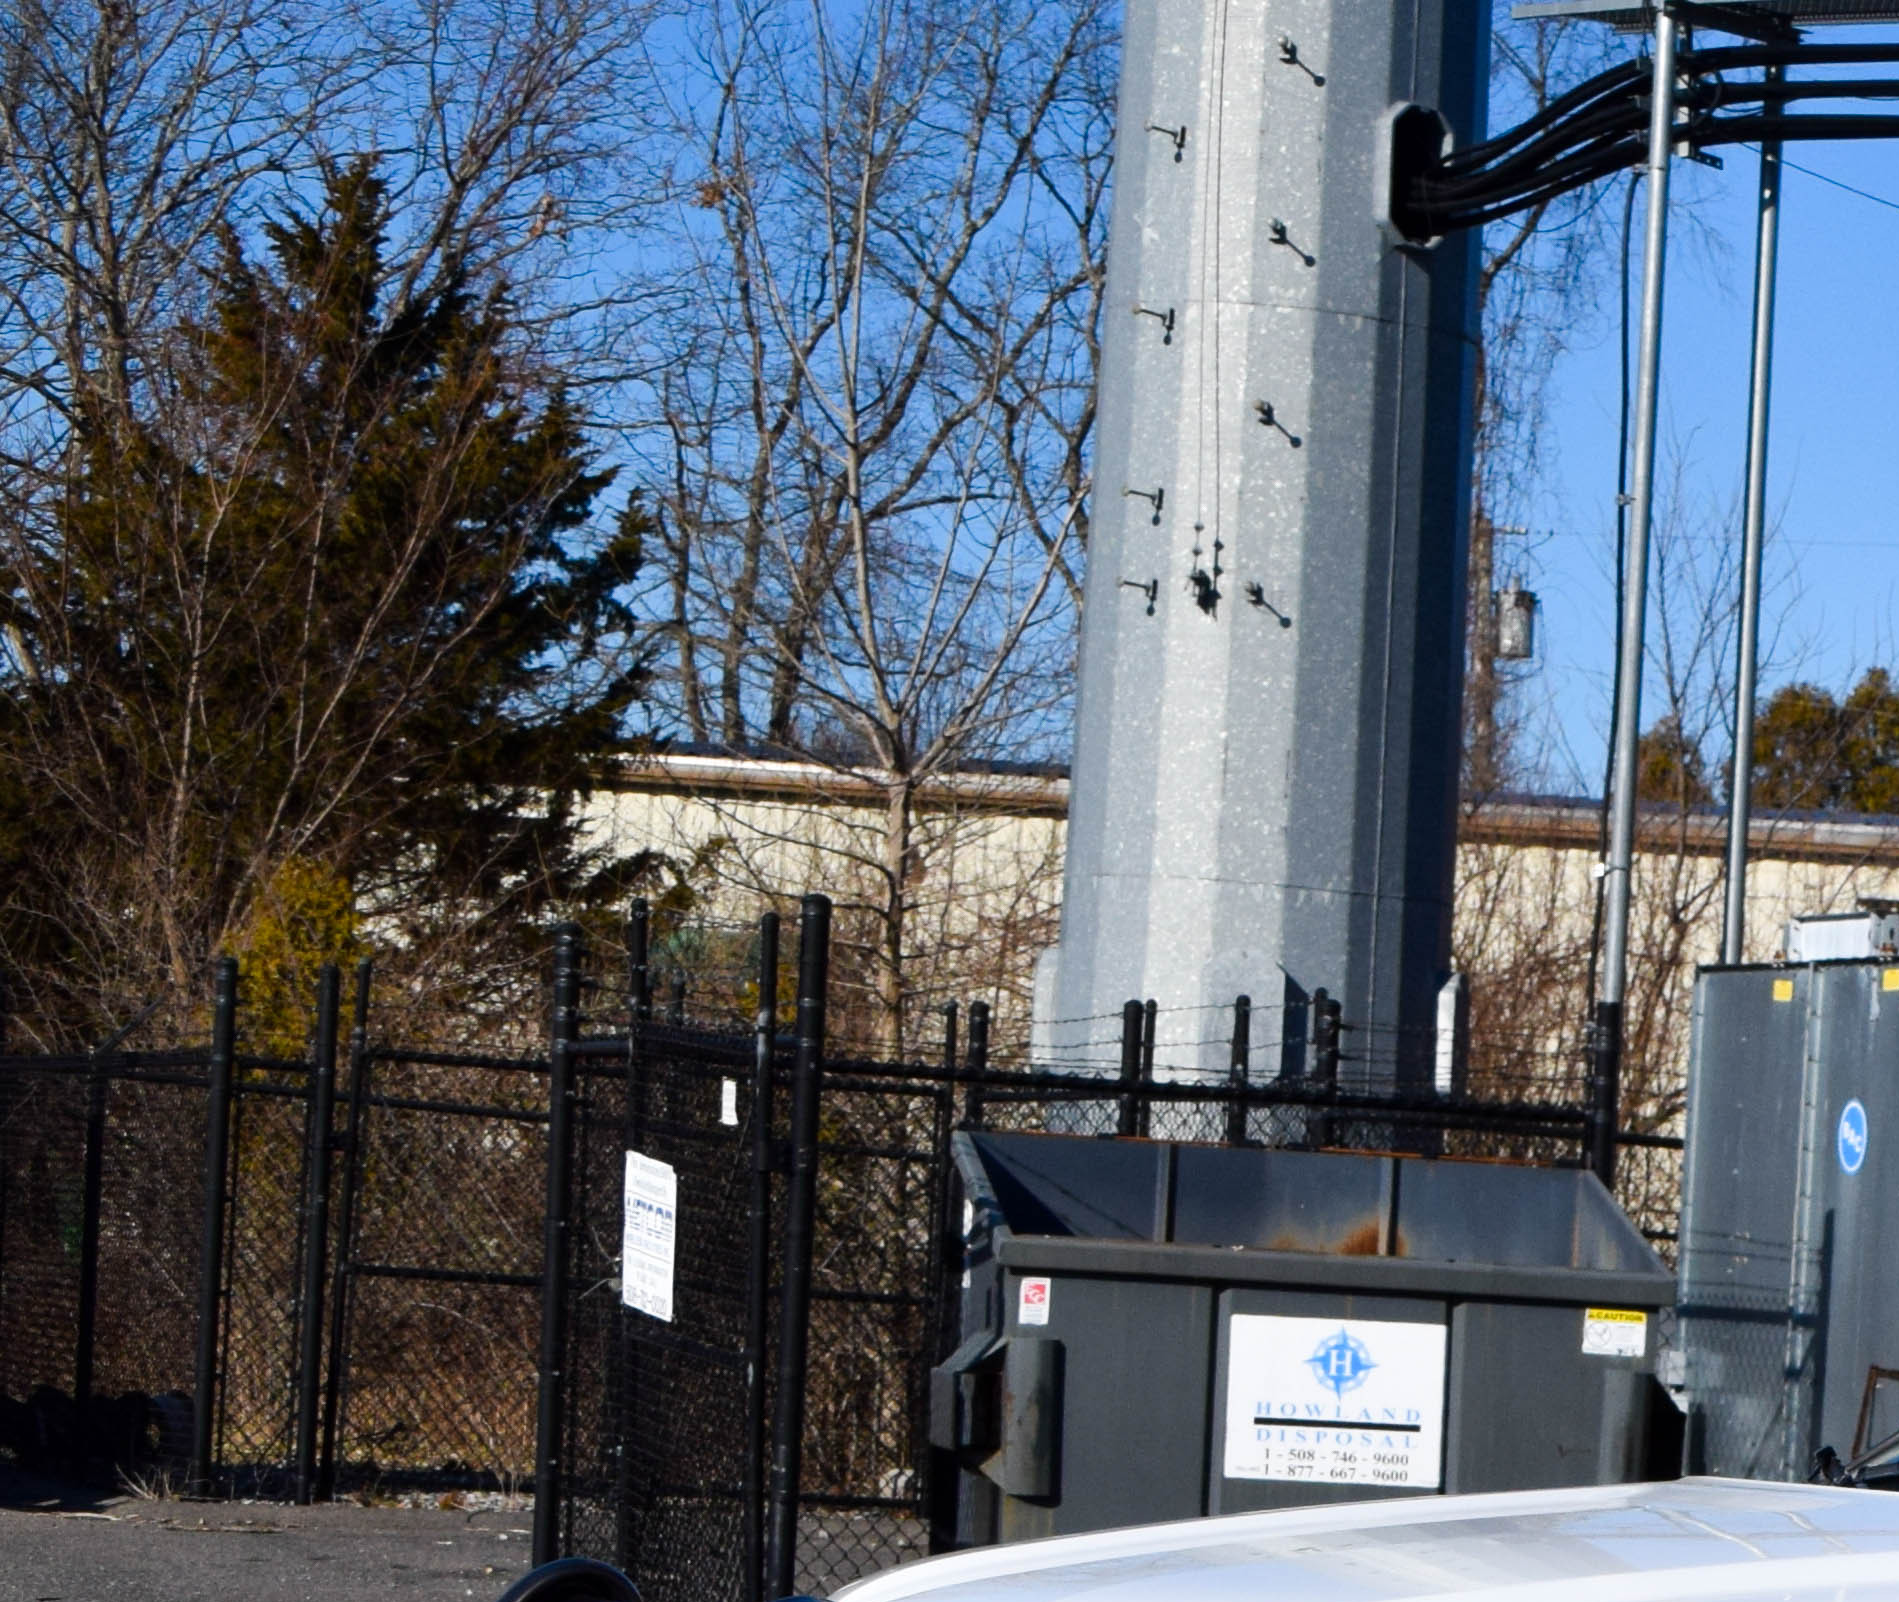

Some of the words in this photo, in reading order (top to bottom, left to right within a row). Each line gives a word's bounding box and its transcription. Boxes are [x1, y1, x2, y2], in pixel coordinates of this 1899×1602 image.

[1596, 1311, 1643, 1322] CAUTION
[1329, 1349, 1354, 1377] H
[1255, 1401, 1421, 1423] HOWLAND
[1256, 1428, 1420, 1449] DISPOSAL
[1287, 1448, 1316, 1462] 508
[1331, 1450, 1358, 1463] 746
[1373, 1452, 1409, 1466] 9600
[1287, 1464, 1314, 1477] 877
[1329, 1466, 1357, 1480] 667
[1372, 1467, 1409, 1482] 9600
